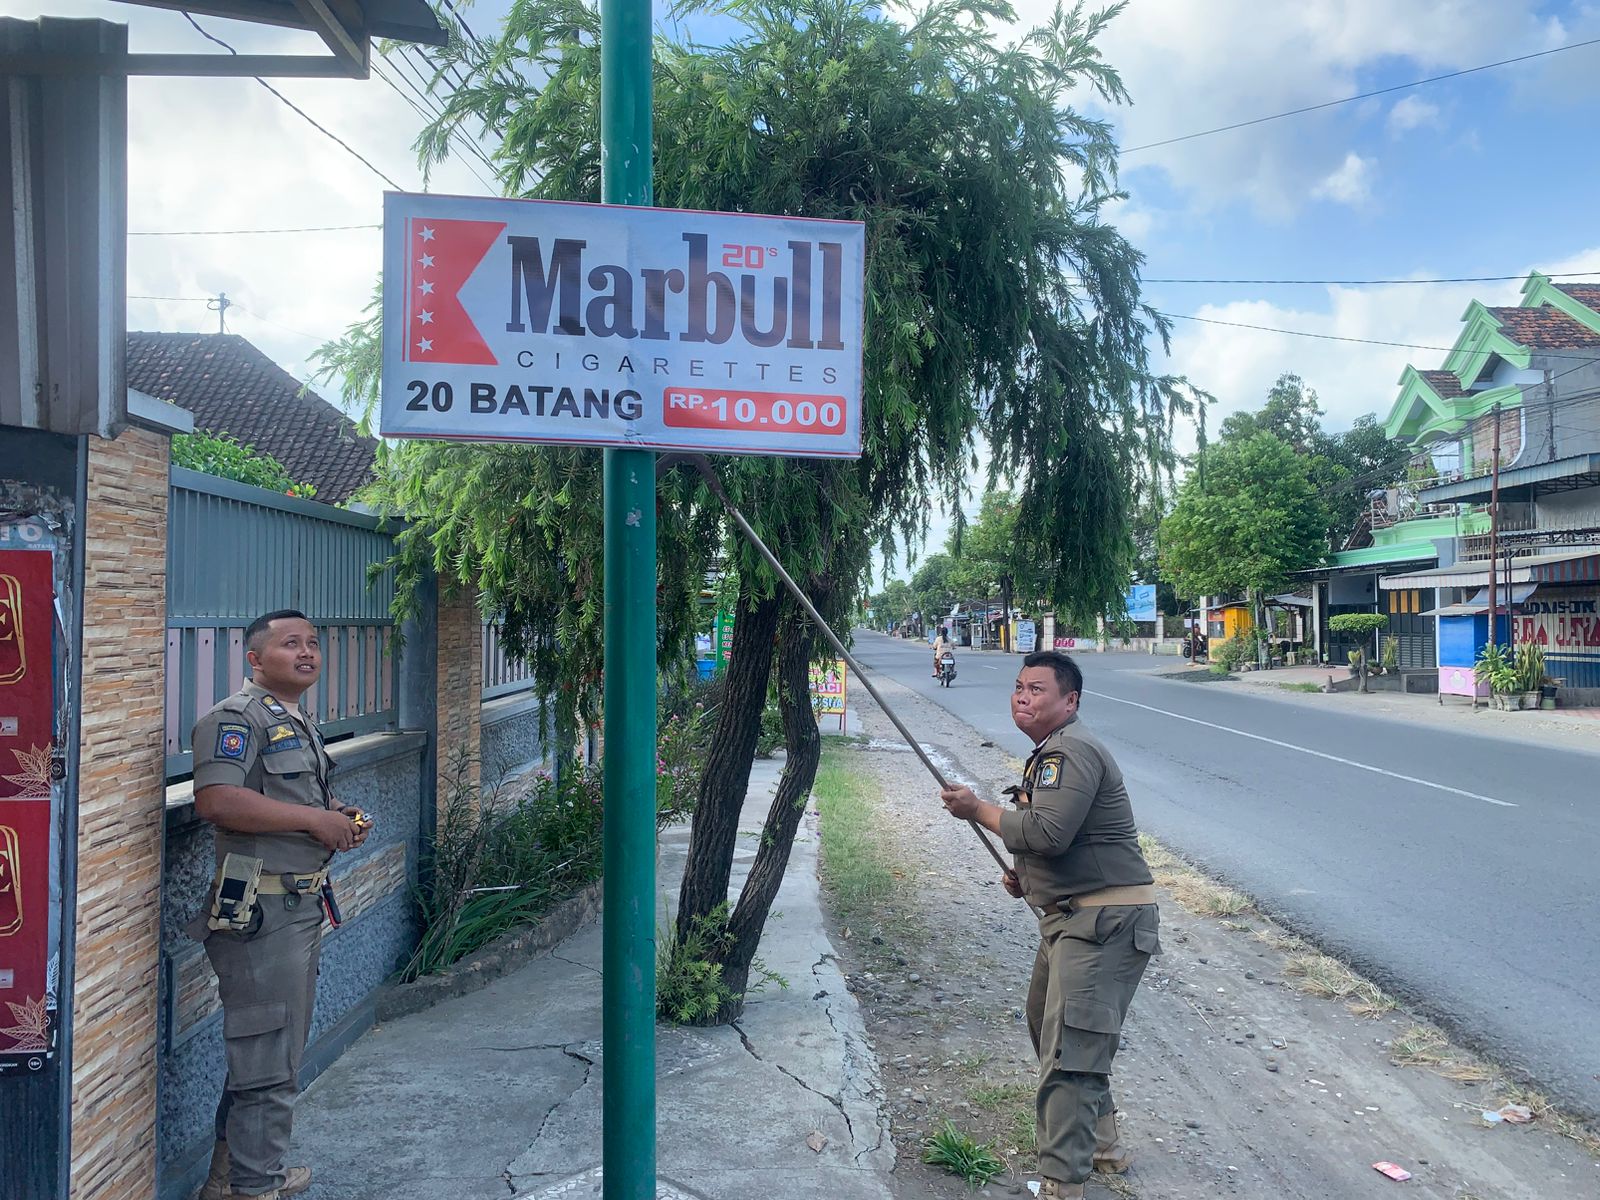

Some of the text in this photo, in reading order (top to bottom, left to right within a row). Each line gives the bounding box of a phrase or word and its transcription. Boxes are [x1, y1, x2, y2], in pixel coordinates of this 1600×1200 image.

[505, 231, 845, 351] Marbull
[516, 350, 837, 385] CIGARETTES
[405, 379, 454, 413] 20
[470, 382, 643, 421] BATANG
